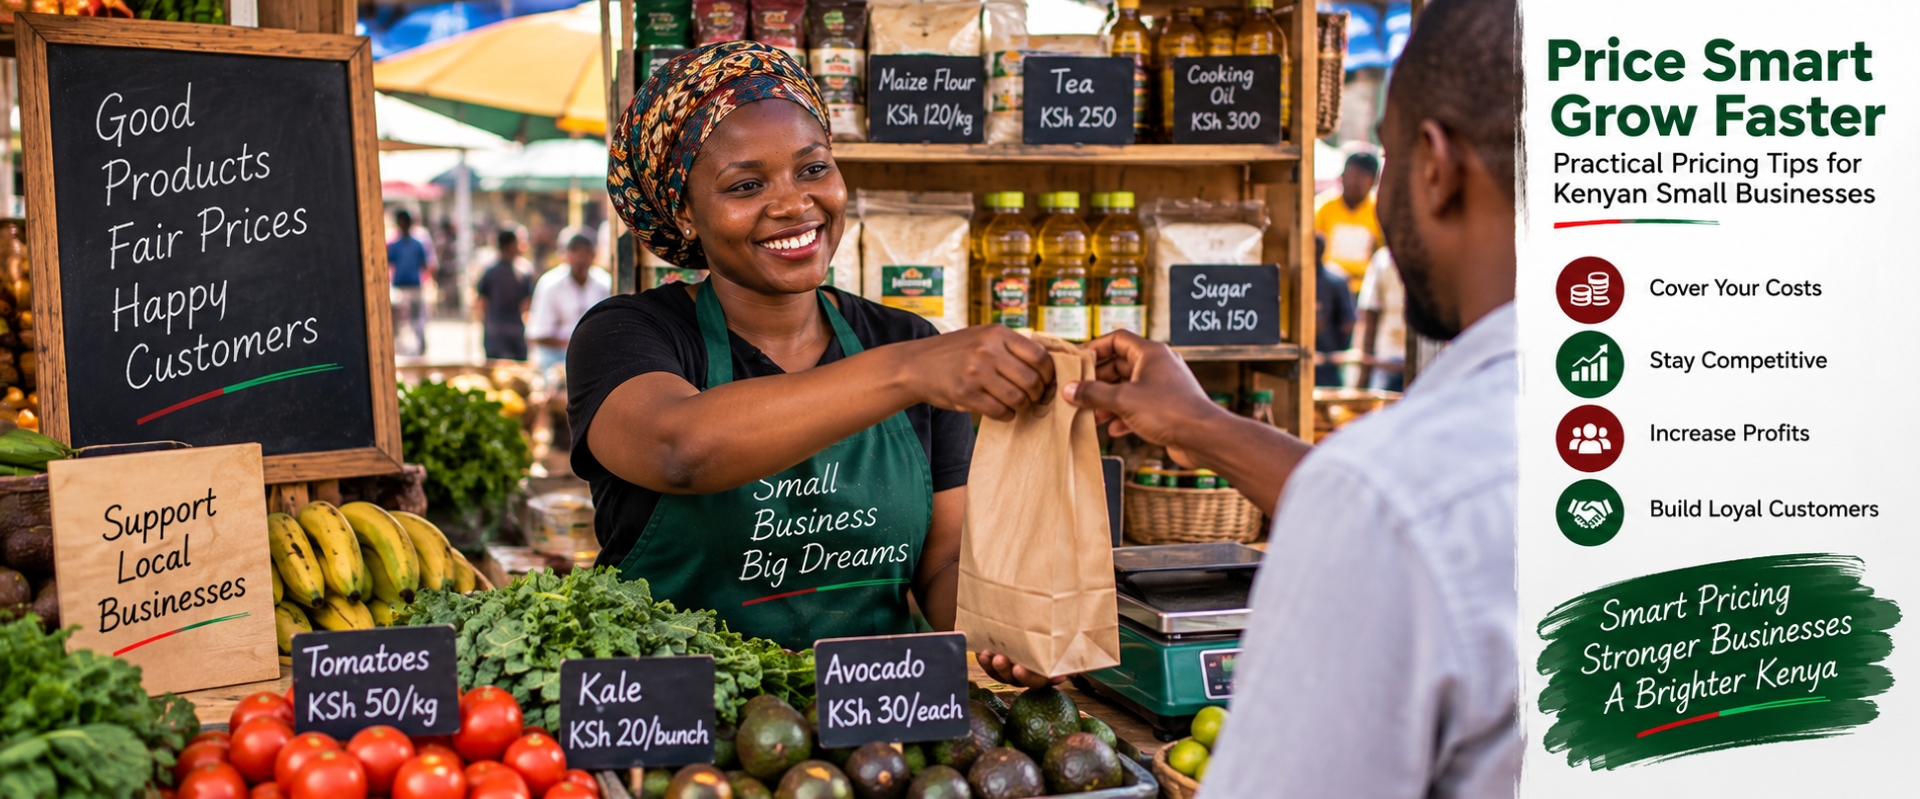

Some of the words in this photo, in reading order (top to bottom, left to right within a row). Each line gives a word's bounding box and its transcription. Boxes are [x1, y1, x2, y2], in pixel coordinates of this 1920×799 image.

[878, 68, 928, 91] Maize
[934, 68, 976, 91] Flour
[1051, 68, 1094, 94] Tea
[1187, 66, 1254, 90] Cooking
[1210, 87, 1235, 105] Oil
[96, 82, 195, 147] Good
[886, 106, 918, 126] KSh
[923, 103, 973, 136] 120/kg
[1040, 106, 1073, 128] KSh
[1079, 106, 1117, 128] 250
[1191, 112, 1222, 131] KSh
[1226, 112, 1260, 130] 300
[102, 143, 271, 206] Products
[108, 222, 183, 270] Fair
[197, 206, 308, 253] Prices
[112, 280, 228, 335] Happy
[1191, 274, 1252, 306] Sugar
[1188, 310, 1221, 332] KSh
[1226, 310, 1258, 331] 150
[126, 317, 319, 390] Customers
[102, 488, 217, 544] Support
[750, 507, 878, 542] Business
[117, 534, 191, 584] Local
[739, 549, 788, 588] Big
[799, 542, 909, 575] Dreams
[98, 577, 246, 634] Businesses
[303, 644, 430, 678] Tomatoes
[824, 648, 925, 685] Avocado
[307, 690, 357, 722] KSh
[364, 684, 439, 728] 50/kg
[578, 670, 642, 706] Kale
[827, 697, 871, 729] KSh
[877, 692, 964, 728] 30/each
[569, 721, 611, 750] KSh
[616, 715, 709, 751] 20/bunch
